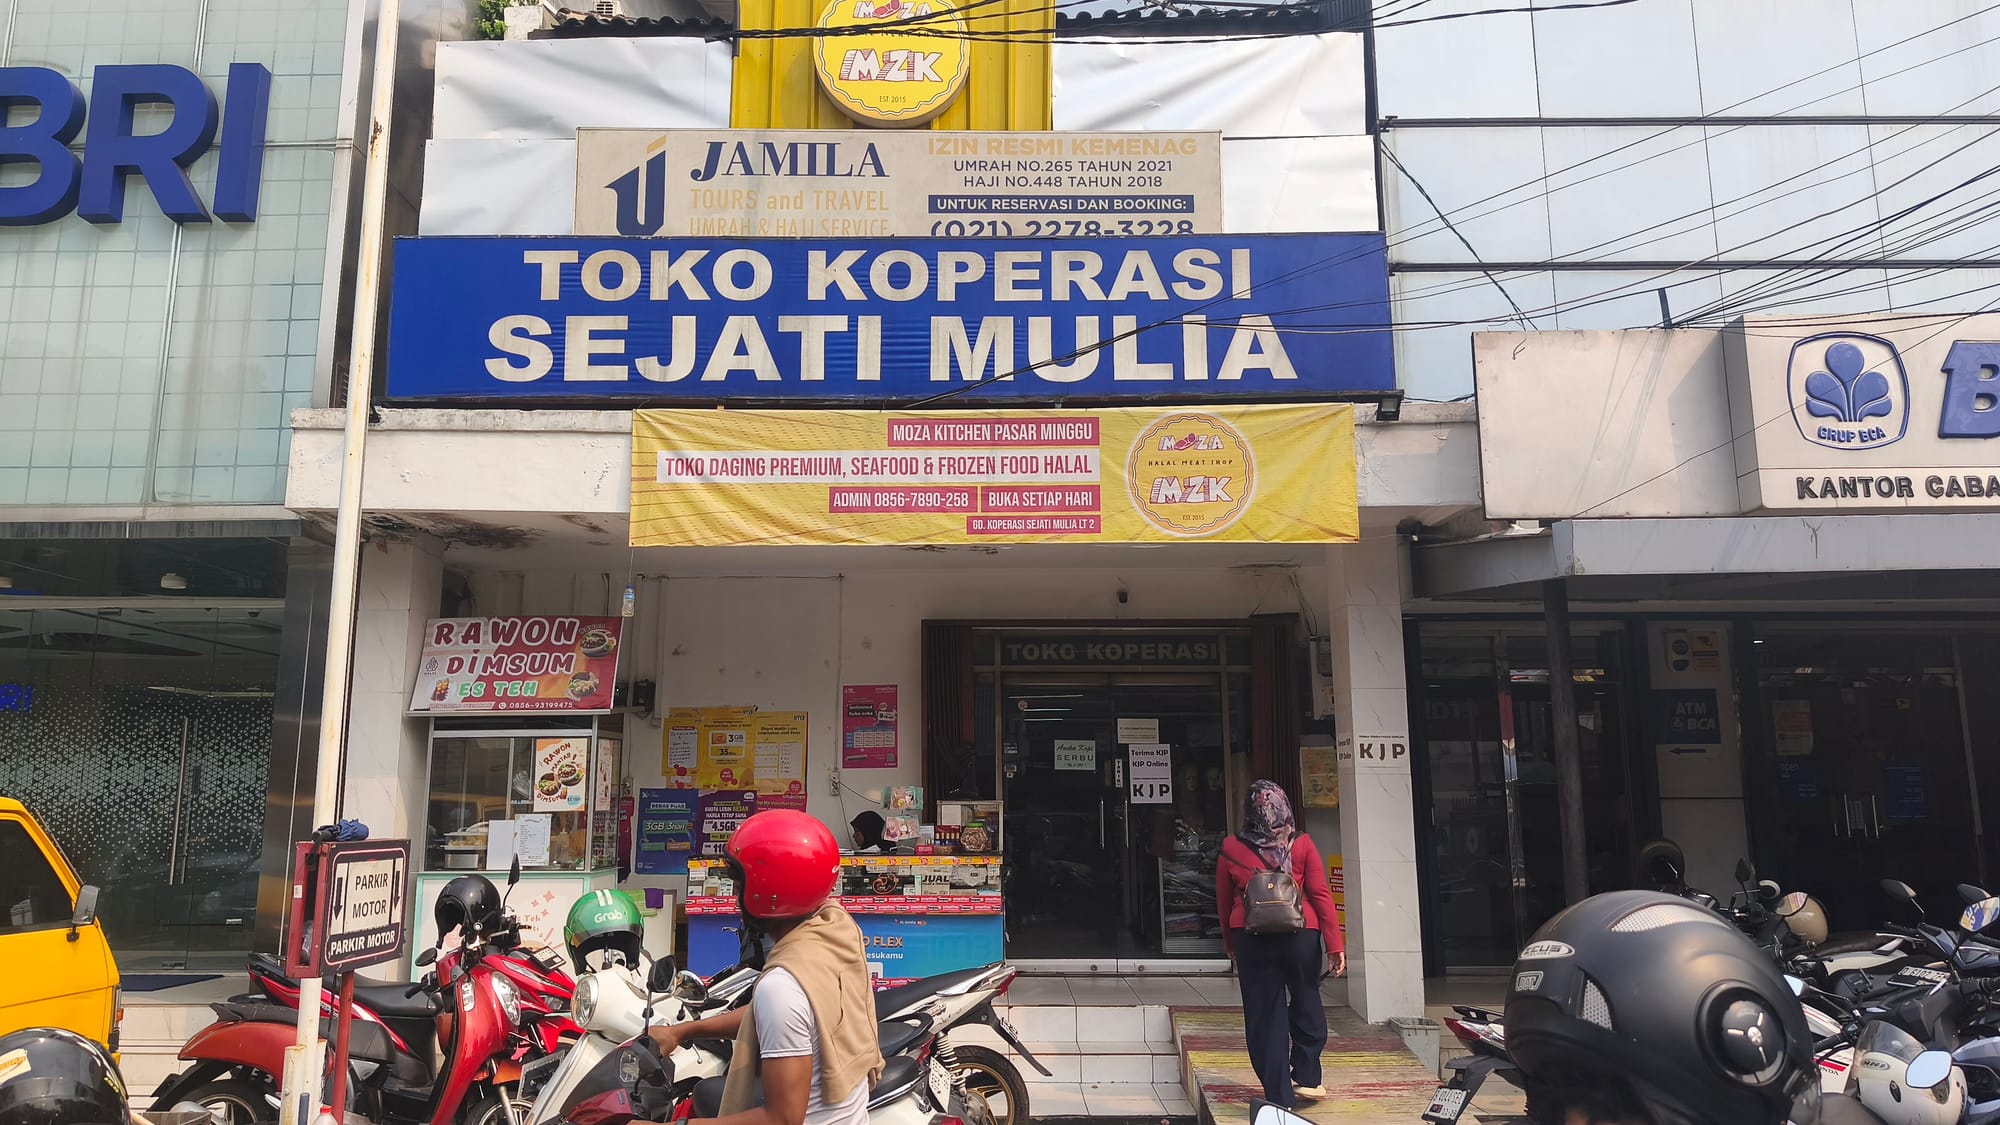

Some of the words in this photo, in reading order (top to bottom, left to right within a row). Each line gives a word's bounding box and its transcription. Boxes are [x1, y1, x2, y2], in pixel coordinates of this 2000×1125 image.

[839, 49, 943, 82] MZK
[891, 95, 907, 103] 2015
[0, 62, 271, 226] BRI
[928, 137, 978, 156] IZIN
[986, 138, 1064, 156] RESMI
[1072, 138, 1198, 157] KEMENAG
[690, 141, 890, 182] JAMILA
[953, 160, 1012, 172] UMRAH
[1017, 160, 1074, 173] NO.265
[1079, 160, 1133, 172] TAHUN
[1138, 160, 1173, 172] 2021
[964, 176, 1000, 188] HAJI
[1005, 176, 1063, 188] NO.448
[1070, 176, 1123, 188] TAHUN
[1127, 176, 1163, 188] 2018
[690, 188, 758, 211] TOURS
[767, 190, 804, 211] and
[813, 190, 889, 211] TRAVEL
[936, 199, 987, 211] UNTUK
[991, 199, 1073, 211] RESERVASI
[1080, 199, 1109, 211] DAN
[1115, 199, 1187, 211] BOOKING:
[523, 249, 774, 302] TOKO
[807, 248, 1252, 302] KOPERASI
[485, 315, 883, 384] SEJATI
[929, 314, 1299, 381] MULIA
[893, 424, 931, 441] MOZA
[935, 424, 993, 441] KITCHEN
[994, 423, 1037, 440] PASAR
[1041, 423, 1092, 440] MINGGU
[1817, 425, 1856, 443] GRUP
[1858, 426, 1886, 443] BCA
[666, 457, 705, 476] TOKO
[709, 457, 766, 476] DAGING
[770, 457, 847, 479] PREMIUM,
[851, 456, 919, 476] SEAFOOD
[924, 457, 933, 475] &
[938, 456, 996, 475] FROZEN
[1000, 455, 1039, 475] FOOD
[1044, 455, 1092, 474] HALAL
[1149, 476, 1234, 504] MZK
[1796, 475, 1914, 500] KANTOR
[1924, 474, 2000, 500] CABA
[833, 492, 871, 507] ADMIN
[874, 492, 969, 507] 0856-7890-258
[988, 492, 1018, 507] BUKA
[1022, 492, 1062, 506] SETIAP
[1066, 491, 1092, 506] HARI
[987, 519, 1025, 530] KOPERASI
[1026, 519, 1052, 530] SEJATI
[1053, 519, 1077, 529] MULIA
[1088, 519, 1095, 529] 2
[434, 618, 579, 646] RAWON
[1008, 644, 1075, 660] TOKO
[1087, 643, 1217, 660] KOPERASI
[458, 682, 485, 697] ES
[494, 681, 538, 697] TEH
[1676, 702, 1707, 715] ATM
[1687, 718, 1715, 730] BCA
[543, 742, 571, 766] RAWON
[712, 821, 736, 832] 4.5GB
[355, 873, 388, 891] PARKIR
[922, 875, 949, 883] JUAL
[352, 900, 387, 919] MOTOR
[594, 910, 623, 924] Grab
[330, 936, 365, 956] PARKIR
[367, 930, 395, 949] MOTOR
[874, 937, 903, 948] FLEX
